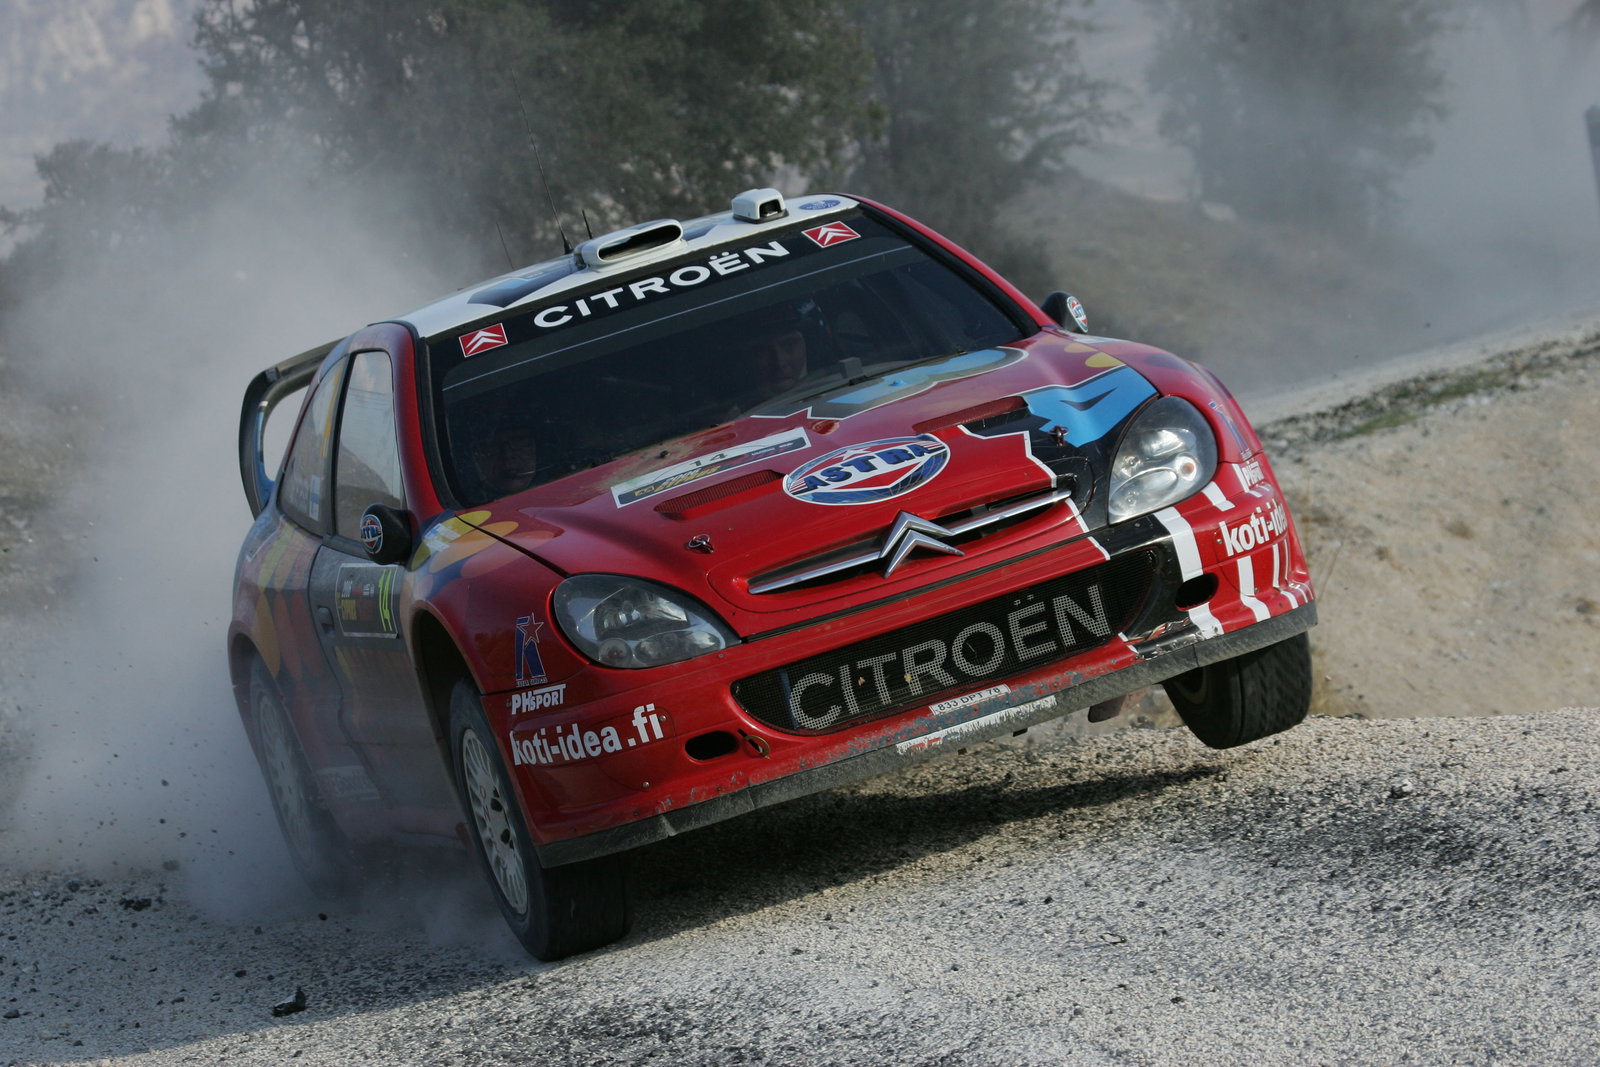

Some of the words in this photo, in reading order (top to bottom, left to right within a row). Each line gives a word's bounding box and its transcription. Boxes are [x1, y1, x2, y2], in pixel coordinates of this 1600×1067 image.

[534, 240, 790, 328] CITROËN
[803, 443, 932, 489] ASTRA
[789, 584, 1112, 731] CITROËN
[938, 700, 959, 712] 833
[960, 692, 984, 704] DPT
